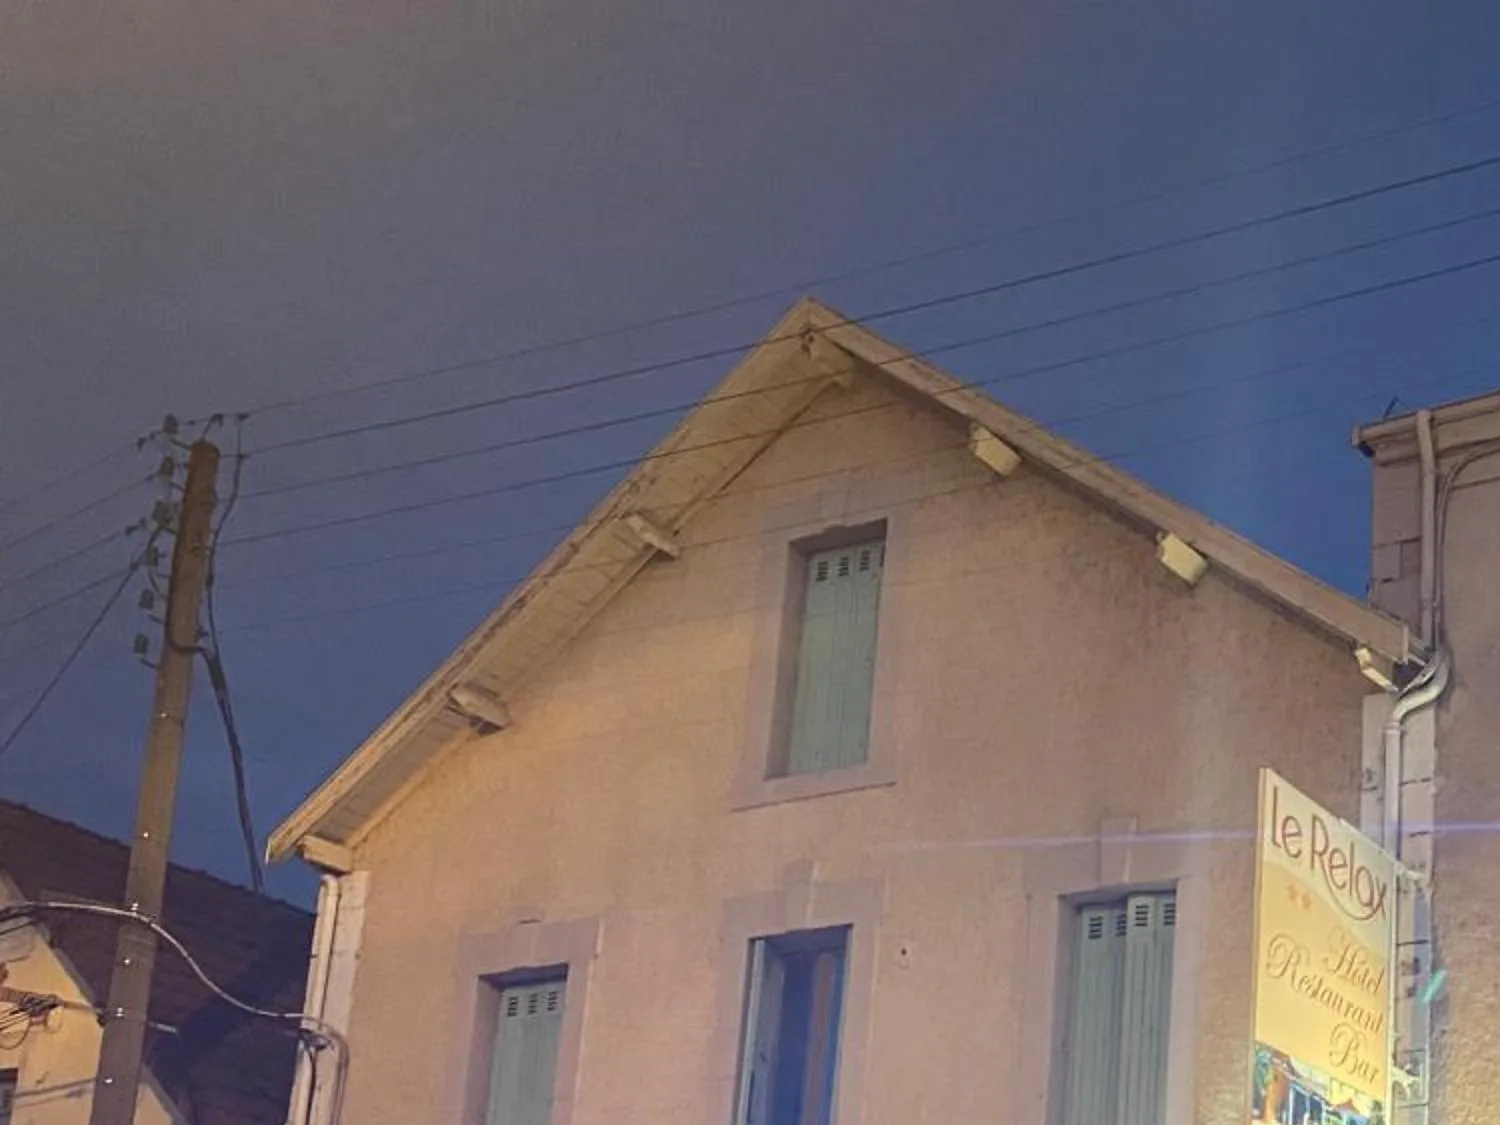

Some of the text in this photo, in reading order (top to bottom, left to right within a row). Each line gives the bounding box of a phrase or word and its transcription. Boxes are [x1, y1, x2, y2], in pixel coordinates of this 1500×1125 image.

[1309, 813, 1386, 921] Relax
[1266, 932, 1384, 1035] Restaurant
[1328, 1021, 1382, 1085] Bar
